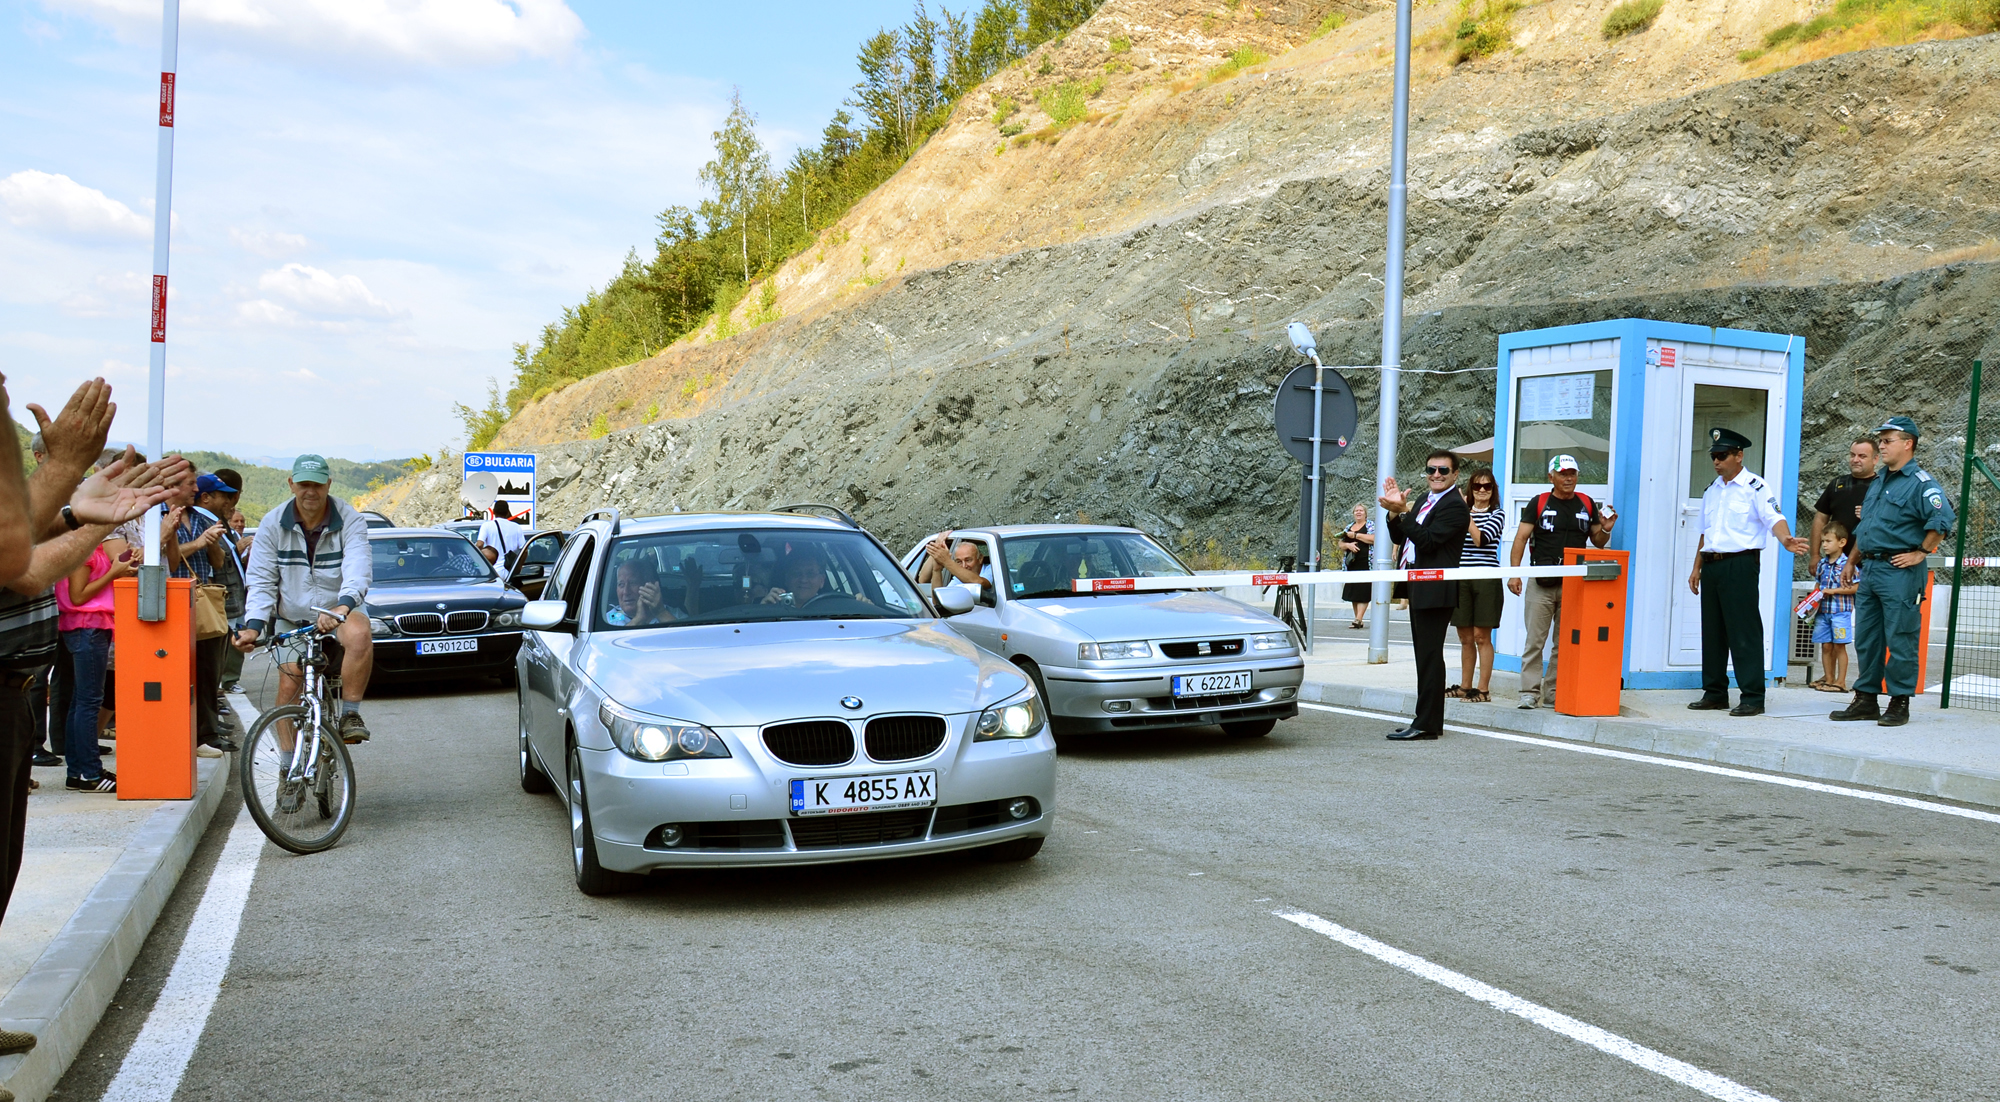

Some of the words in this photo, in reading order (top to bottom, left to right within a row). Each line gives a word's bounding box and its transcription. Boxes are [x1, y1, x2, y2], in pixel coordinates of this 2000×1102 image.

[469, 457, 480, 465] BG
[485, 456, 534, 468] BULGARIA
[1964, 557, 1985, 566] STOP
[423, 643, 436, 653] CA
[438, 641, 462, 652] 9012
[463, 640, 476, 650] CC
[1186, 678, 1194, 692] K
[1201, 675, 1231, 691] 6222
[1234, 674, 1249, 688] AT
[793, 799, 804, 807] BG
[815, 782, 830, 806] K
[843, 778, 899, 803] 4855
[904, 775, 931, 799] AX
[828, 806, 869, 814] DIDOAUTO
